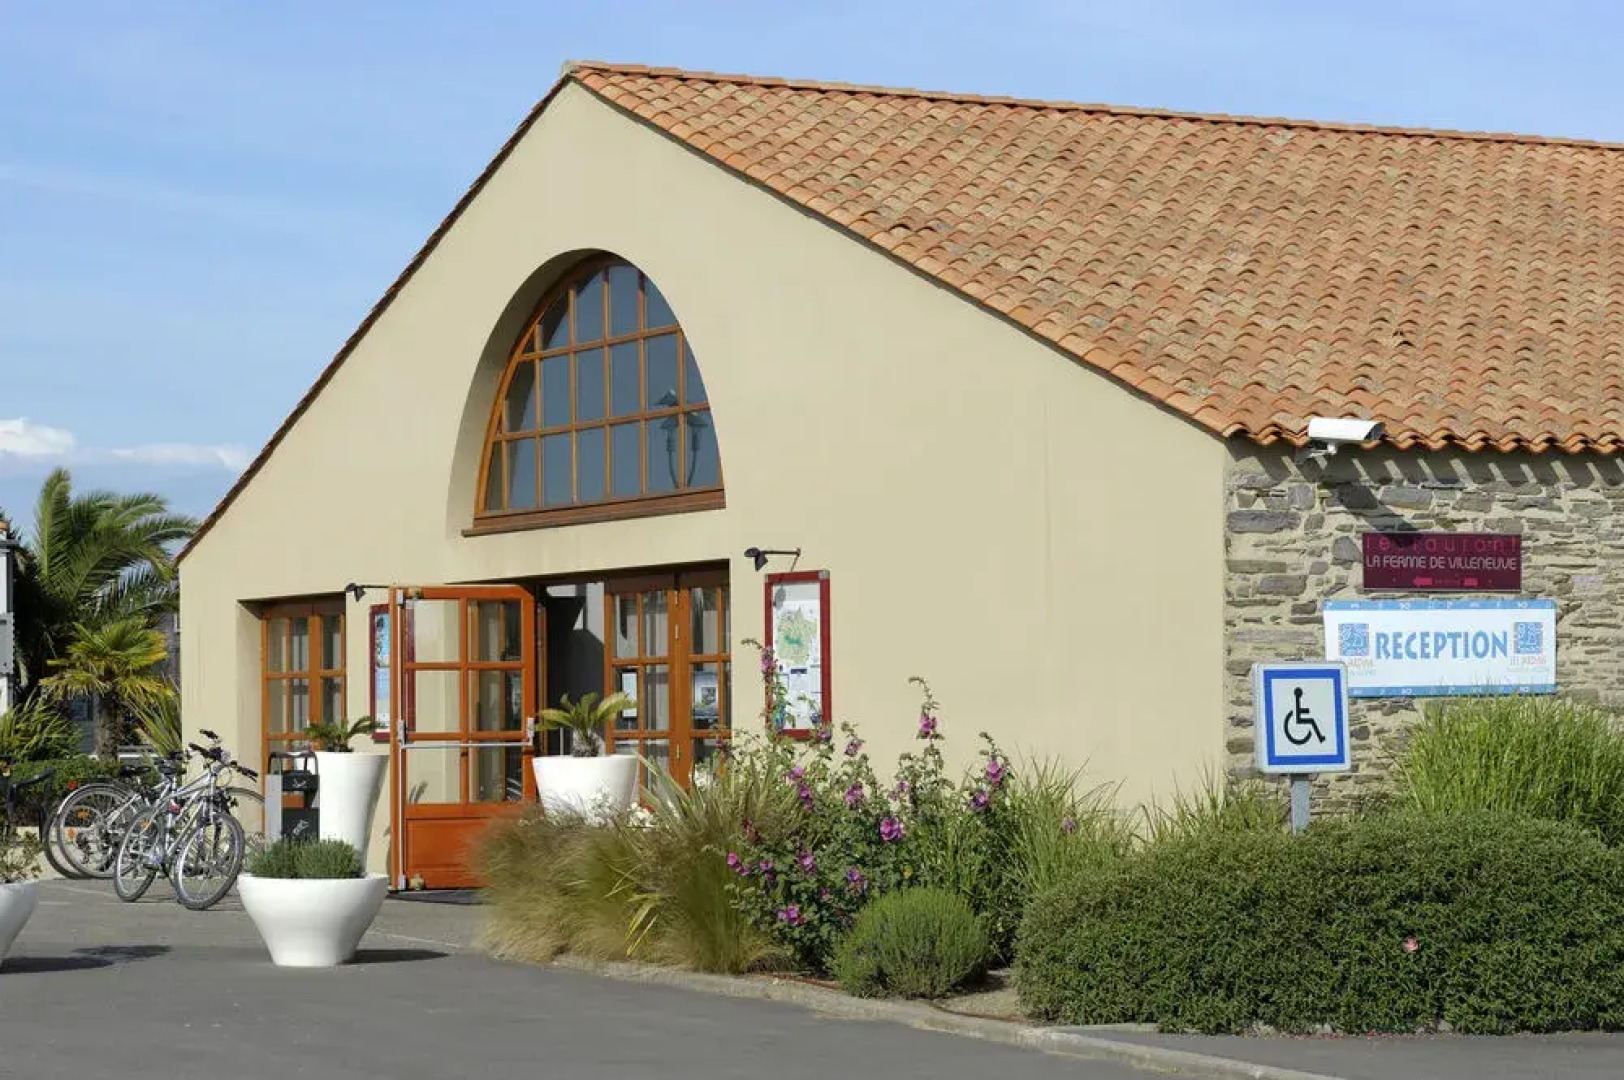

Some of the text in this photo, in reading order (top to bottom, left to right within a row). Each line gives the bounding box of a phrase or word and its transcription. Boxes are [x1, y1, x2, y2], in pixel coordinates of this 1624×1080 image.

[1366, 536, 1517, 553] retaurant
[1365, 555, 1518, 571] LA FERME DE VILLENEUVE
[1375, 630, 1508, 660] RECEPTION
